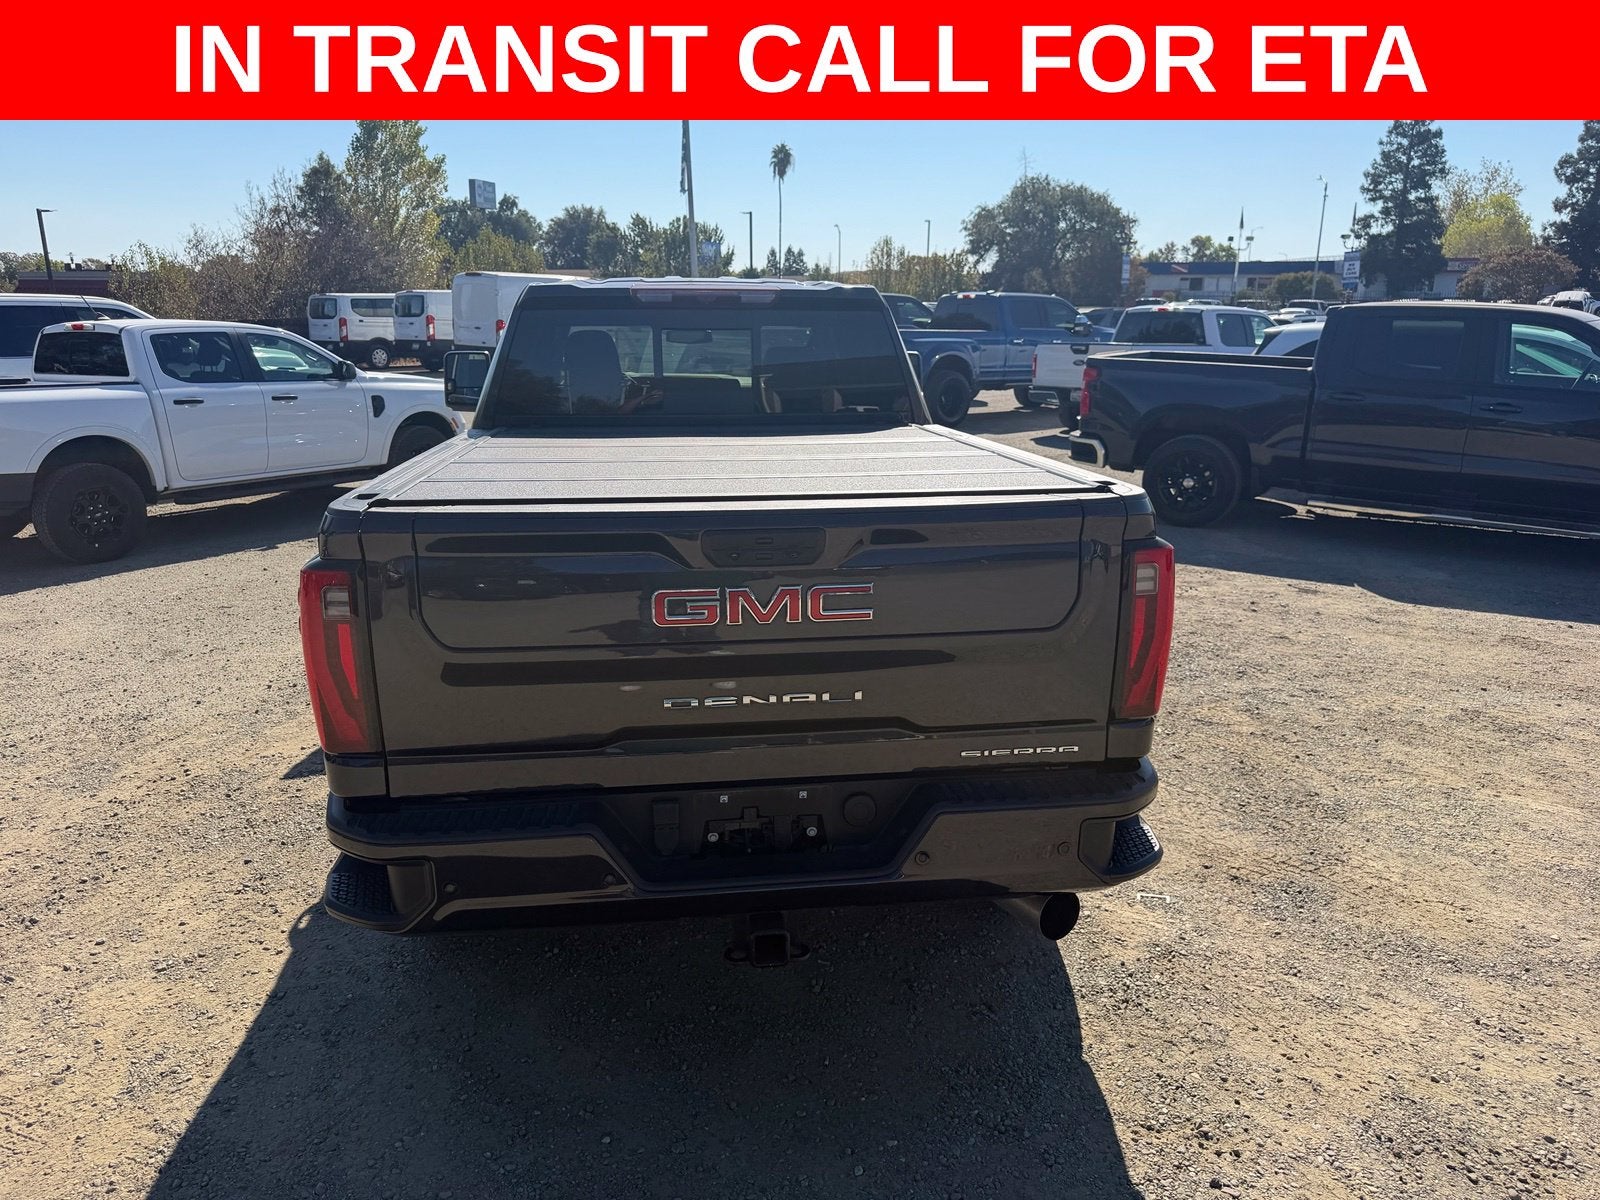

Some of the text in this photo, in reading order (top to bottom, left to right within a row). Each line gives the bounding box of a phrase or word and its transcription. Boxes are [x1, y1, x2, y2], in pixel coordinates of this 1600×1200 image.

[651, 583, 874, 628] GMC
[663, 690, 863, 709] DENALI
[960, 745, 1079, 757] SIERRA
